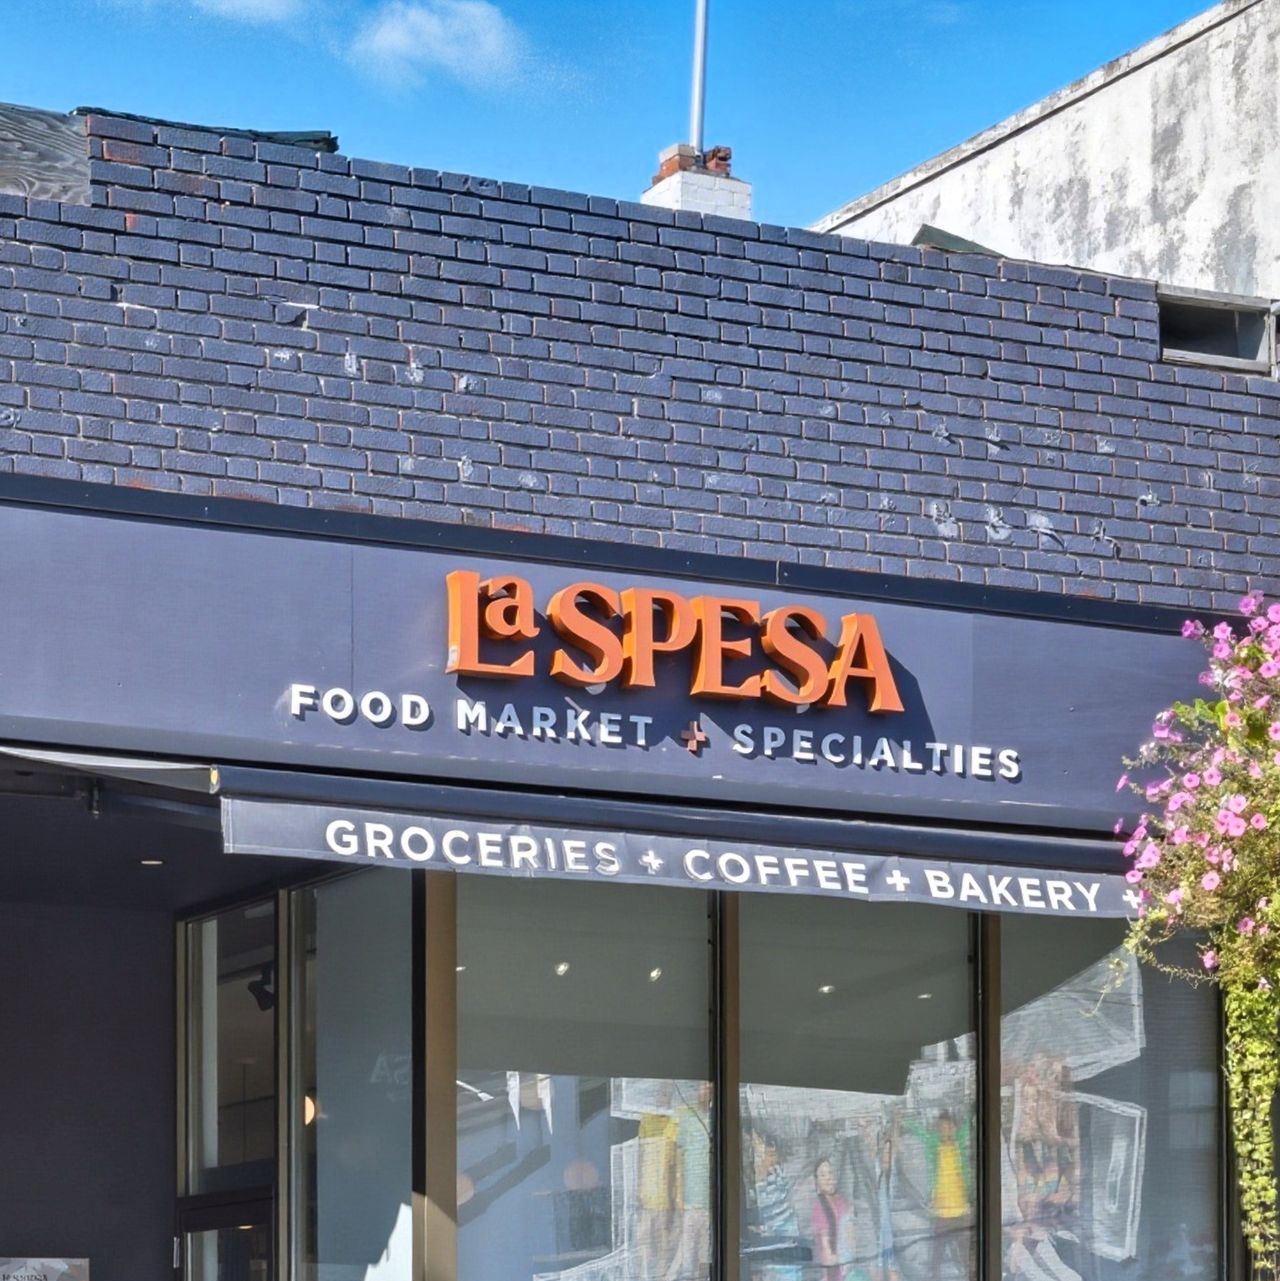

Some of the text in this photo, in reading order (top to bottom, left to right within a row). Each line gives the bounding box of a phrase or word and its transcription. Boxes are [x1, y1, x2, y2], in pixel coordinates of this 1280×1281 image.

[290, 683, 431, 726] FOOD
[457, 699, 653, 746] MARKET
[732, 723, 1021, 779] SPECIALTIES
[325, 819, 620, 876] GROCERIES
[683, 848, 869, 894] COFFEE
[924, 868, 1100, 912] BAKERY
